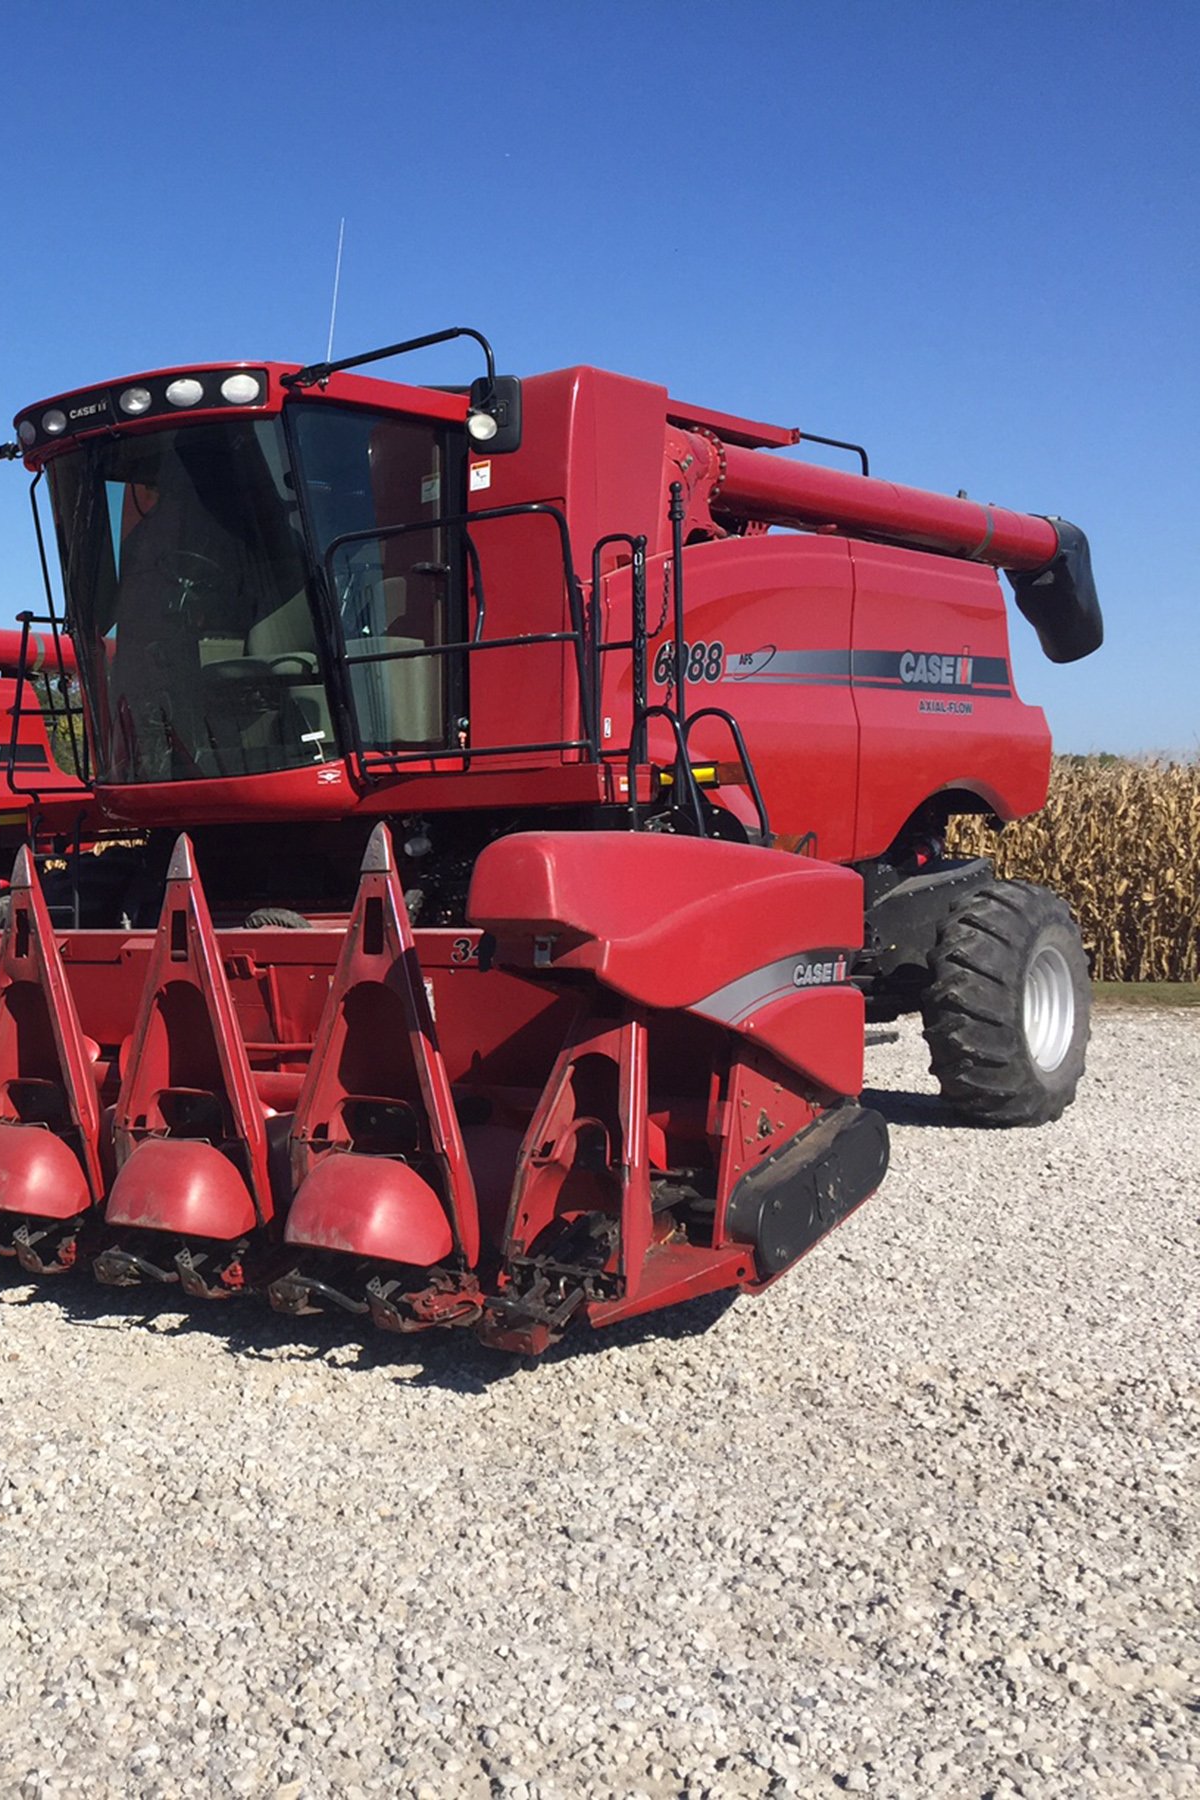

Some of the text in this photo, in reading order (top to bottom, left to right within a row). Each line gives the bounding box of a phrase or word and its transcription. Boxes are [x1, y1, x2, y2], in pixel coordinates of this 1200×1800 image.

[69, 404, 96, 419] CASE
[900, 651, 954, 685] CASE
[918, 700, 973, 715] AXIAL-FLOW
[793, 961, 832, 986] CASE
